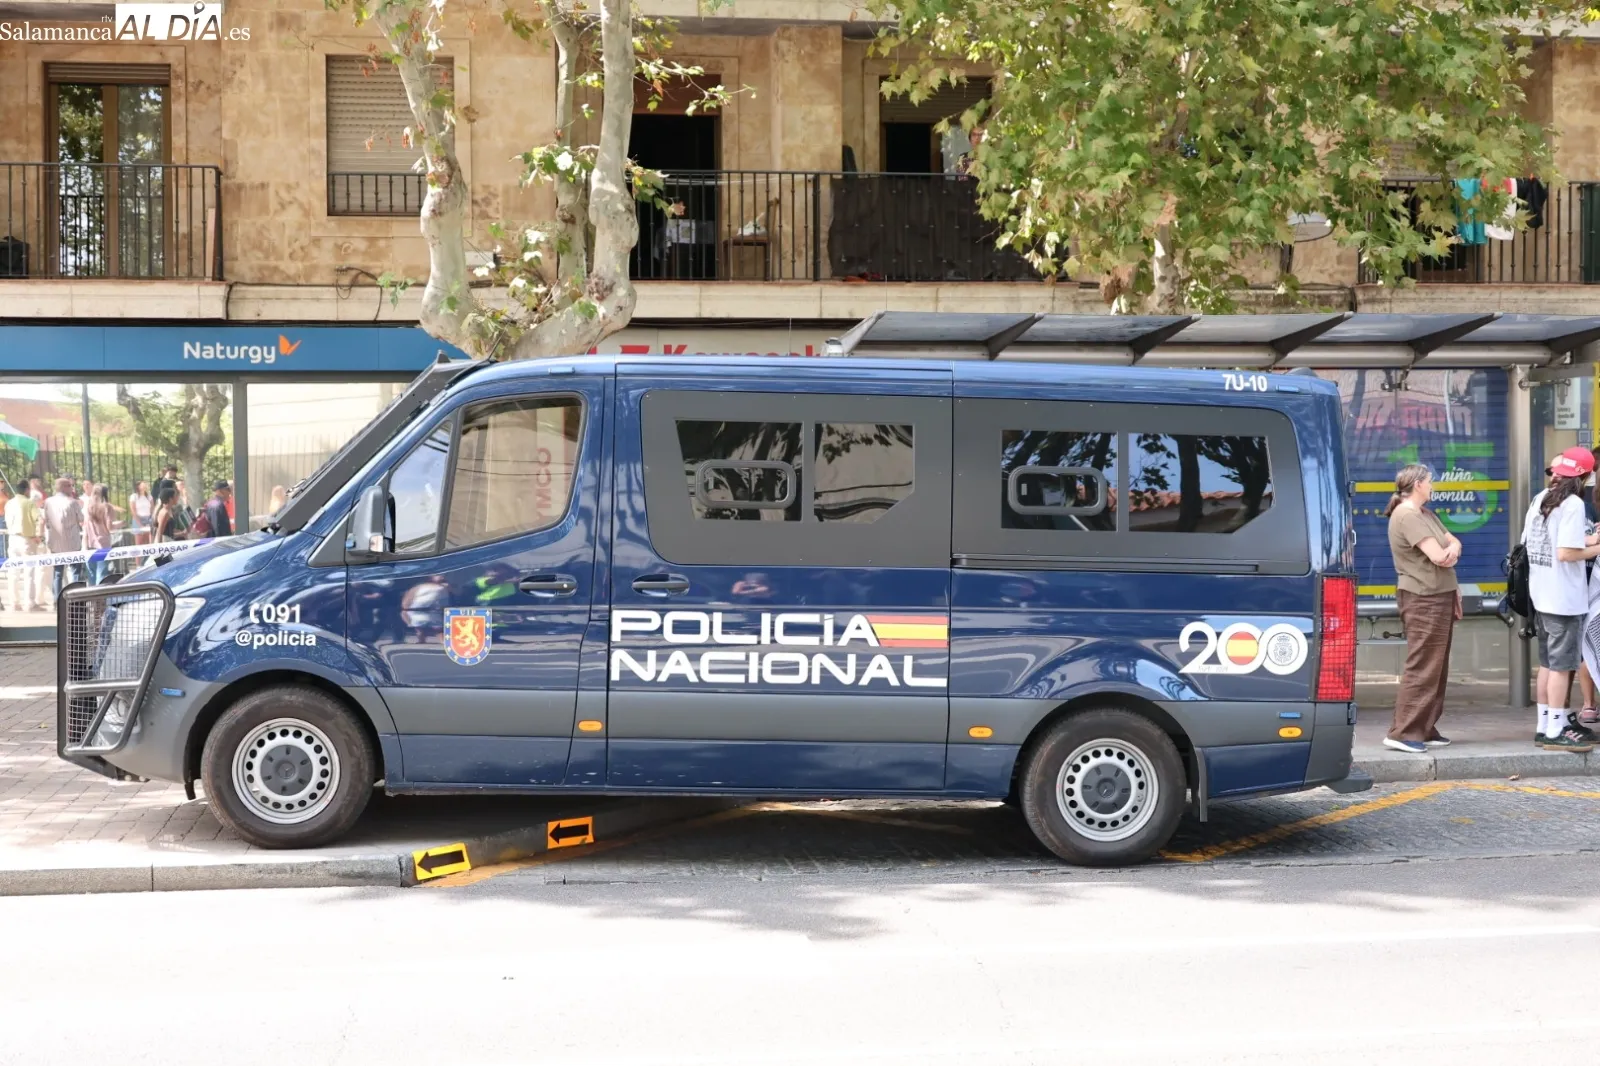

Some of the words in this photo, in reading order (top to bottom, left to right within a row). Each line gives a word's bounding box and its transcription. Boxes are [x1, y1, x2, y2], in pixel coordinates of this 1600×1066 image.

[183, 341, 276, 364] Naturgy
[1222, 373, 1268, 392] 7U-10
[1441, 467, 1475, 482] niña
[38, 558, 52, 567] NO
[54, 554, 86, 565] PASAR
[142, 547, 156, 556] NO
[158, 544, 189, 555] PASAR
[262, 603, 301, 624] 091
[235, 629, 317, 650] @policia
[1178, 621, 1308, 675] 200
[610, 649, 948, 687] NACIONAL
